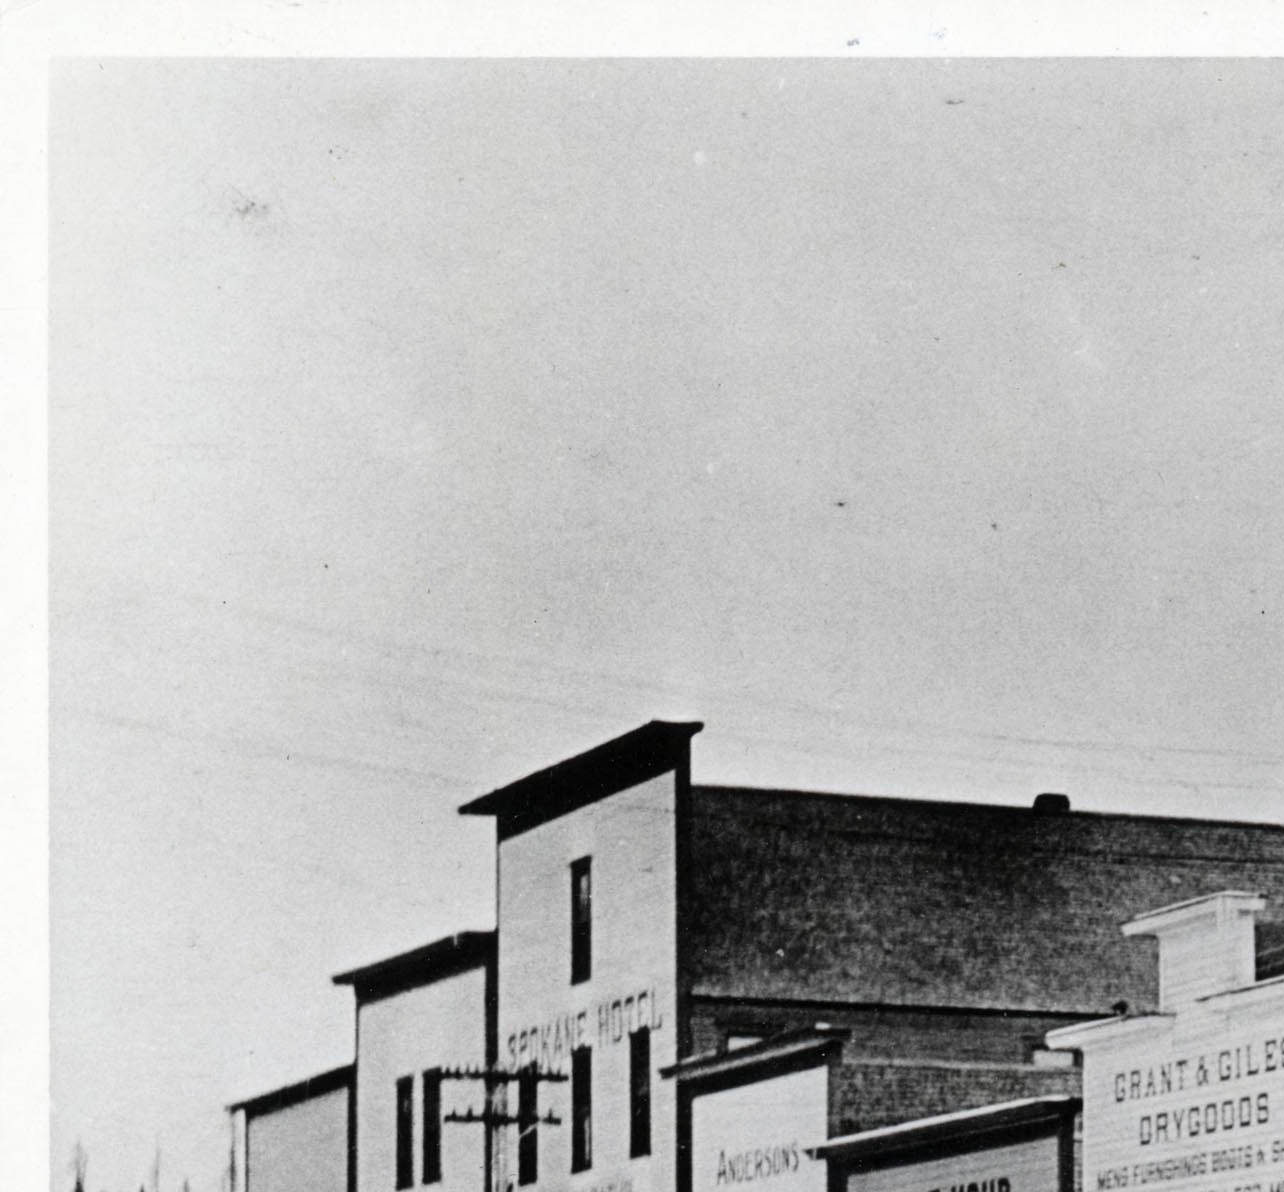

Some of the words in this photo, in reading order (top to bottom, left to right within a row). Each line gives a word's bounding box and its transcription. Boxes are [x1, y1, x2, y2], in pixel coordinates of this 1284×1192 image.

[1114, 1059, 1188, 1104] GRANT
[1196, 1055, 1210, 1088] &
[1140, 1092, 1270, 1146] DRYGOODS
[1211, 1144, 1253, 1173] BOOTS
